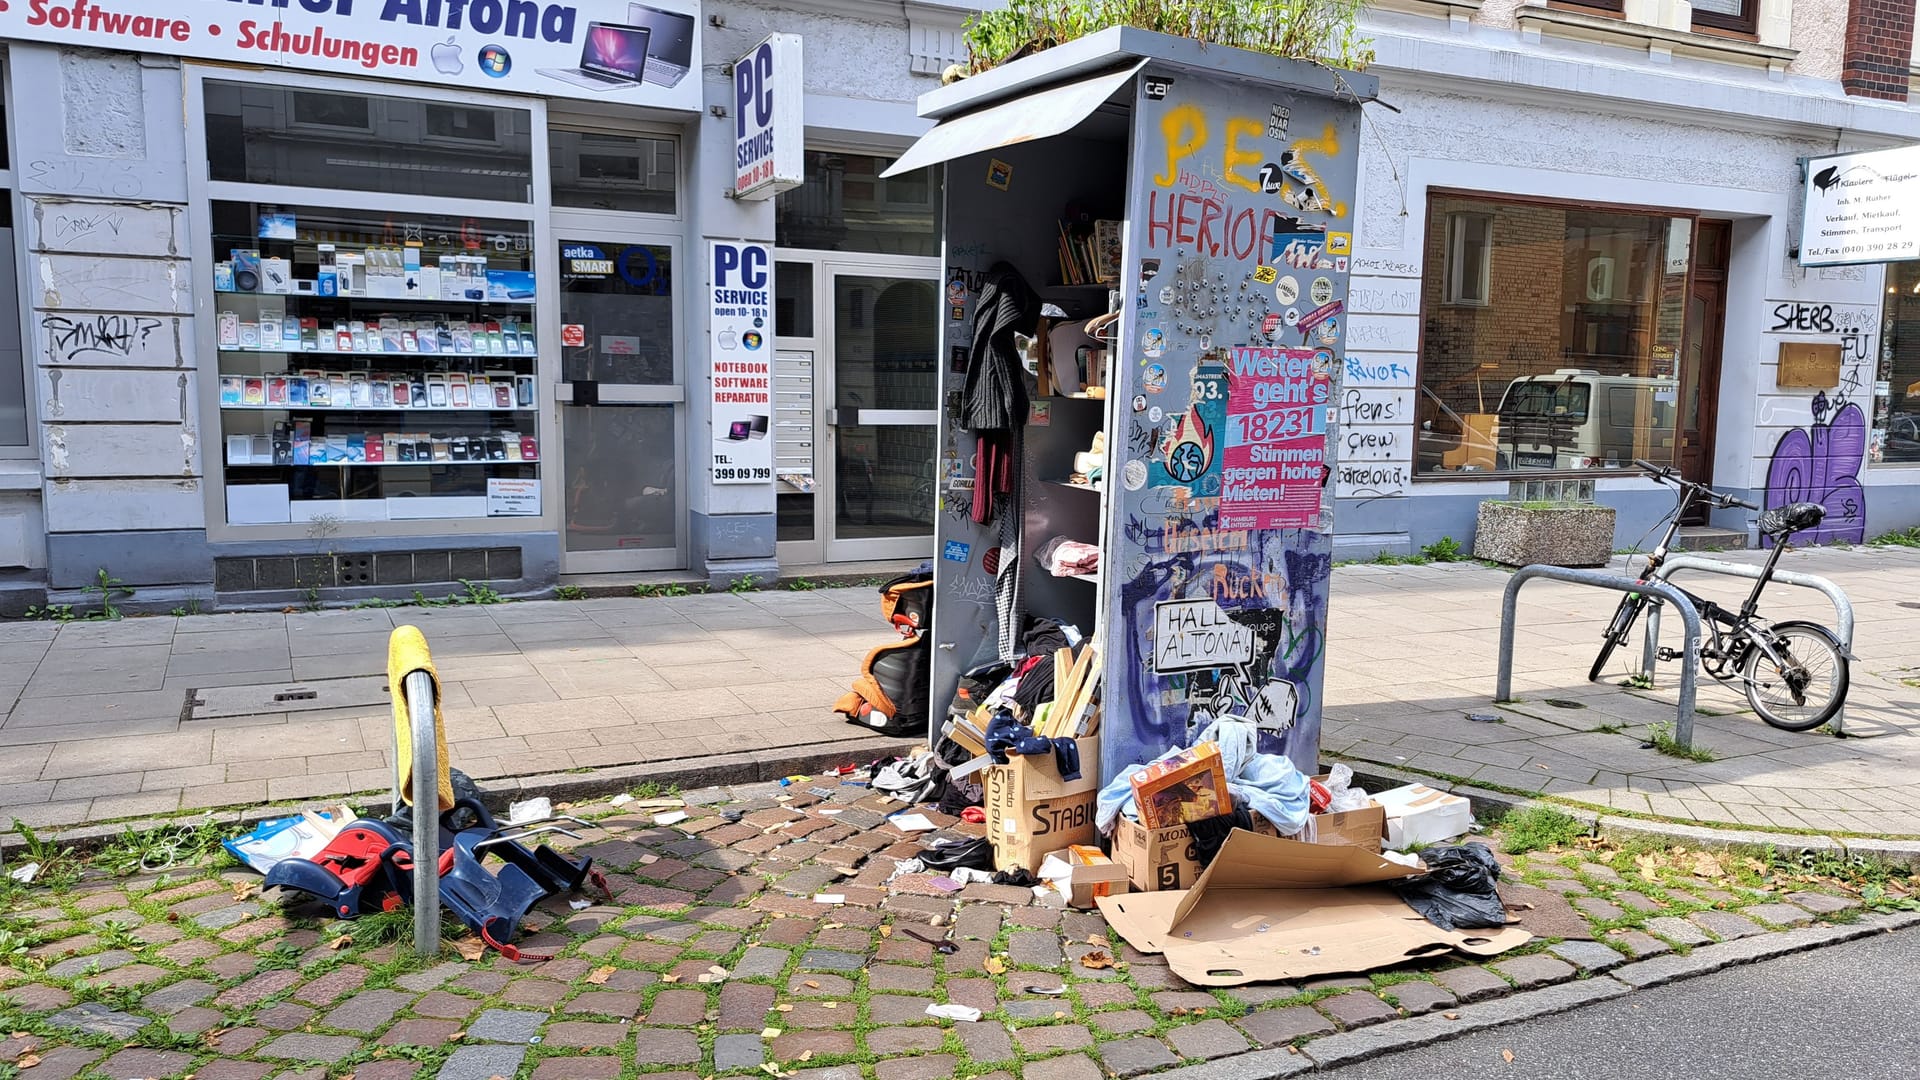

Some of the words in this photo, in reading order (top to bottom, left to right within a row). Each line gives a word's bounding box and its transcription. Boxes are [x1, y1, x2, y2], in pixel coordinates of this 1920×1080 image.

[26, 0, 190, 42] Software
[237, 19, 418, 68] Schulungen
[736, 43, 773, 139] PC
[1270, 115, 1289, 130] DIAR
[737, 126, 773, 169] SERVICE
[738, 172, 752, 190] open
[1840, 178, 1873, 188] Klaviere
[1862, 224, 1902, 234] Transport
[563, 246, 595, 259] aetka
[1807, 246, 1840, 257] Tel./Fax
[1841, 245, 1865, 255] (040)
[1867, 243, 1884, 253] 390
[1886, 241, 1899, 251] 28
[1901, 241, 1914, 250] 29
[572, 260, 614, 274] SMART
[714, 244, 768, 290] PC
[714, 290, 768, 306] SERVICE
[714, 308, 736, 317] open
[751, 307, 761, 317] 18
[762, 308, 768, 317] h
[714, 362, 768, 374] NOTEBOOK
[1232, 349, 1311, 378] Weiter
[714, 377, 768, 389] SOFTWARE
[714, 392, 768, 404] REPARATUR
[1253, 377, 1328, 409] geht's
[1238, 407, 1314, 443] 18231
[714, 455, 733, 464] TEL.:
[1250, 445, 1322, 463] Stimmen
[714, 468, 735, 479] 399
[737, 468, 750, 479] 09
[752, 468, 770, 479] 799
[1223, 466, 1278, 485] gegen
[1281, 463, 1321, 480] hohe
[1222, 484, 1286, 502] Mieten!
[1168, 606, 1237, 632] HALL
[1161, 630, 1250, 665] ALTONA!
[991, 768, 1006, 859] STABILUS
[1162, 866, 1176, 886] 5
